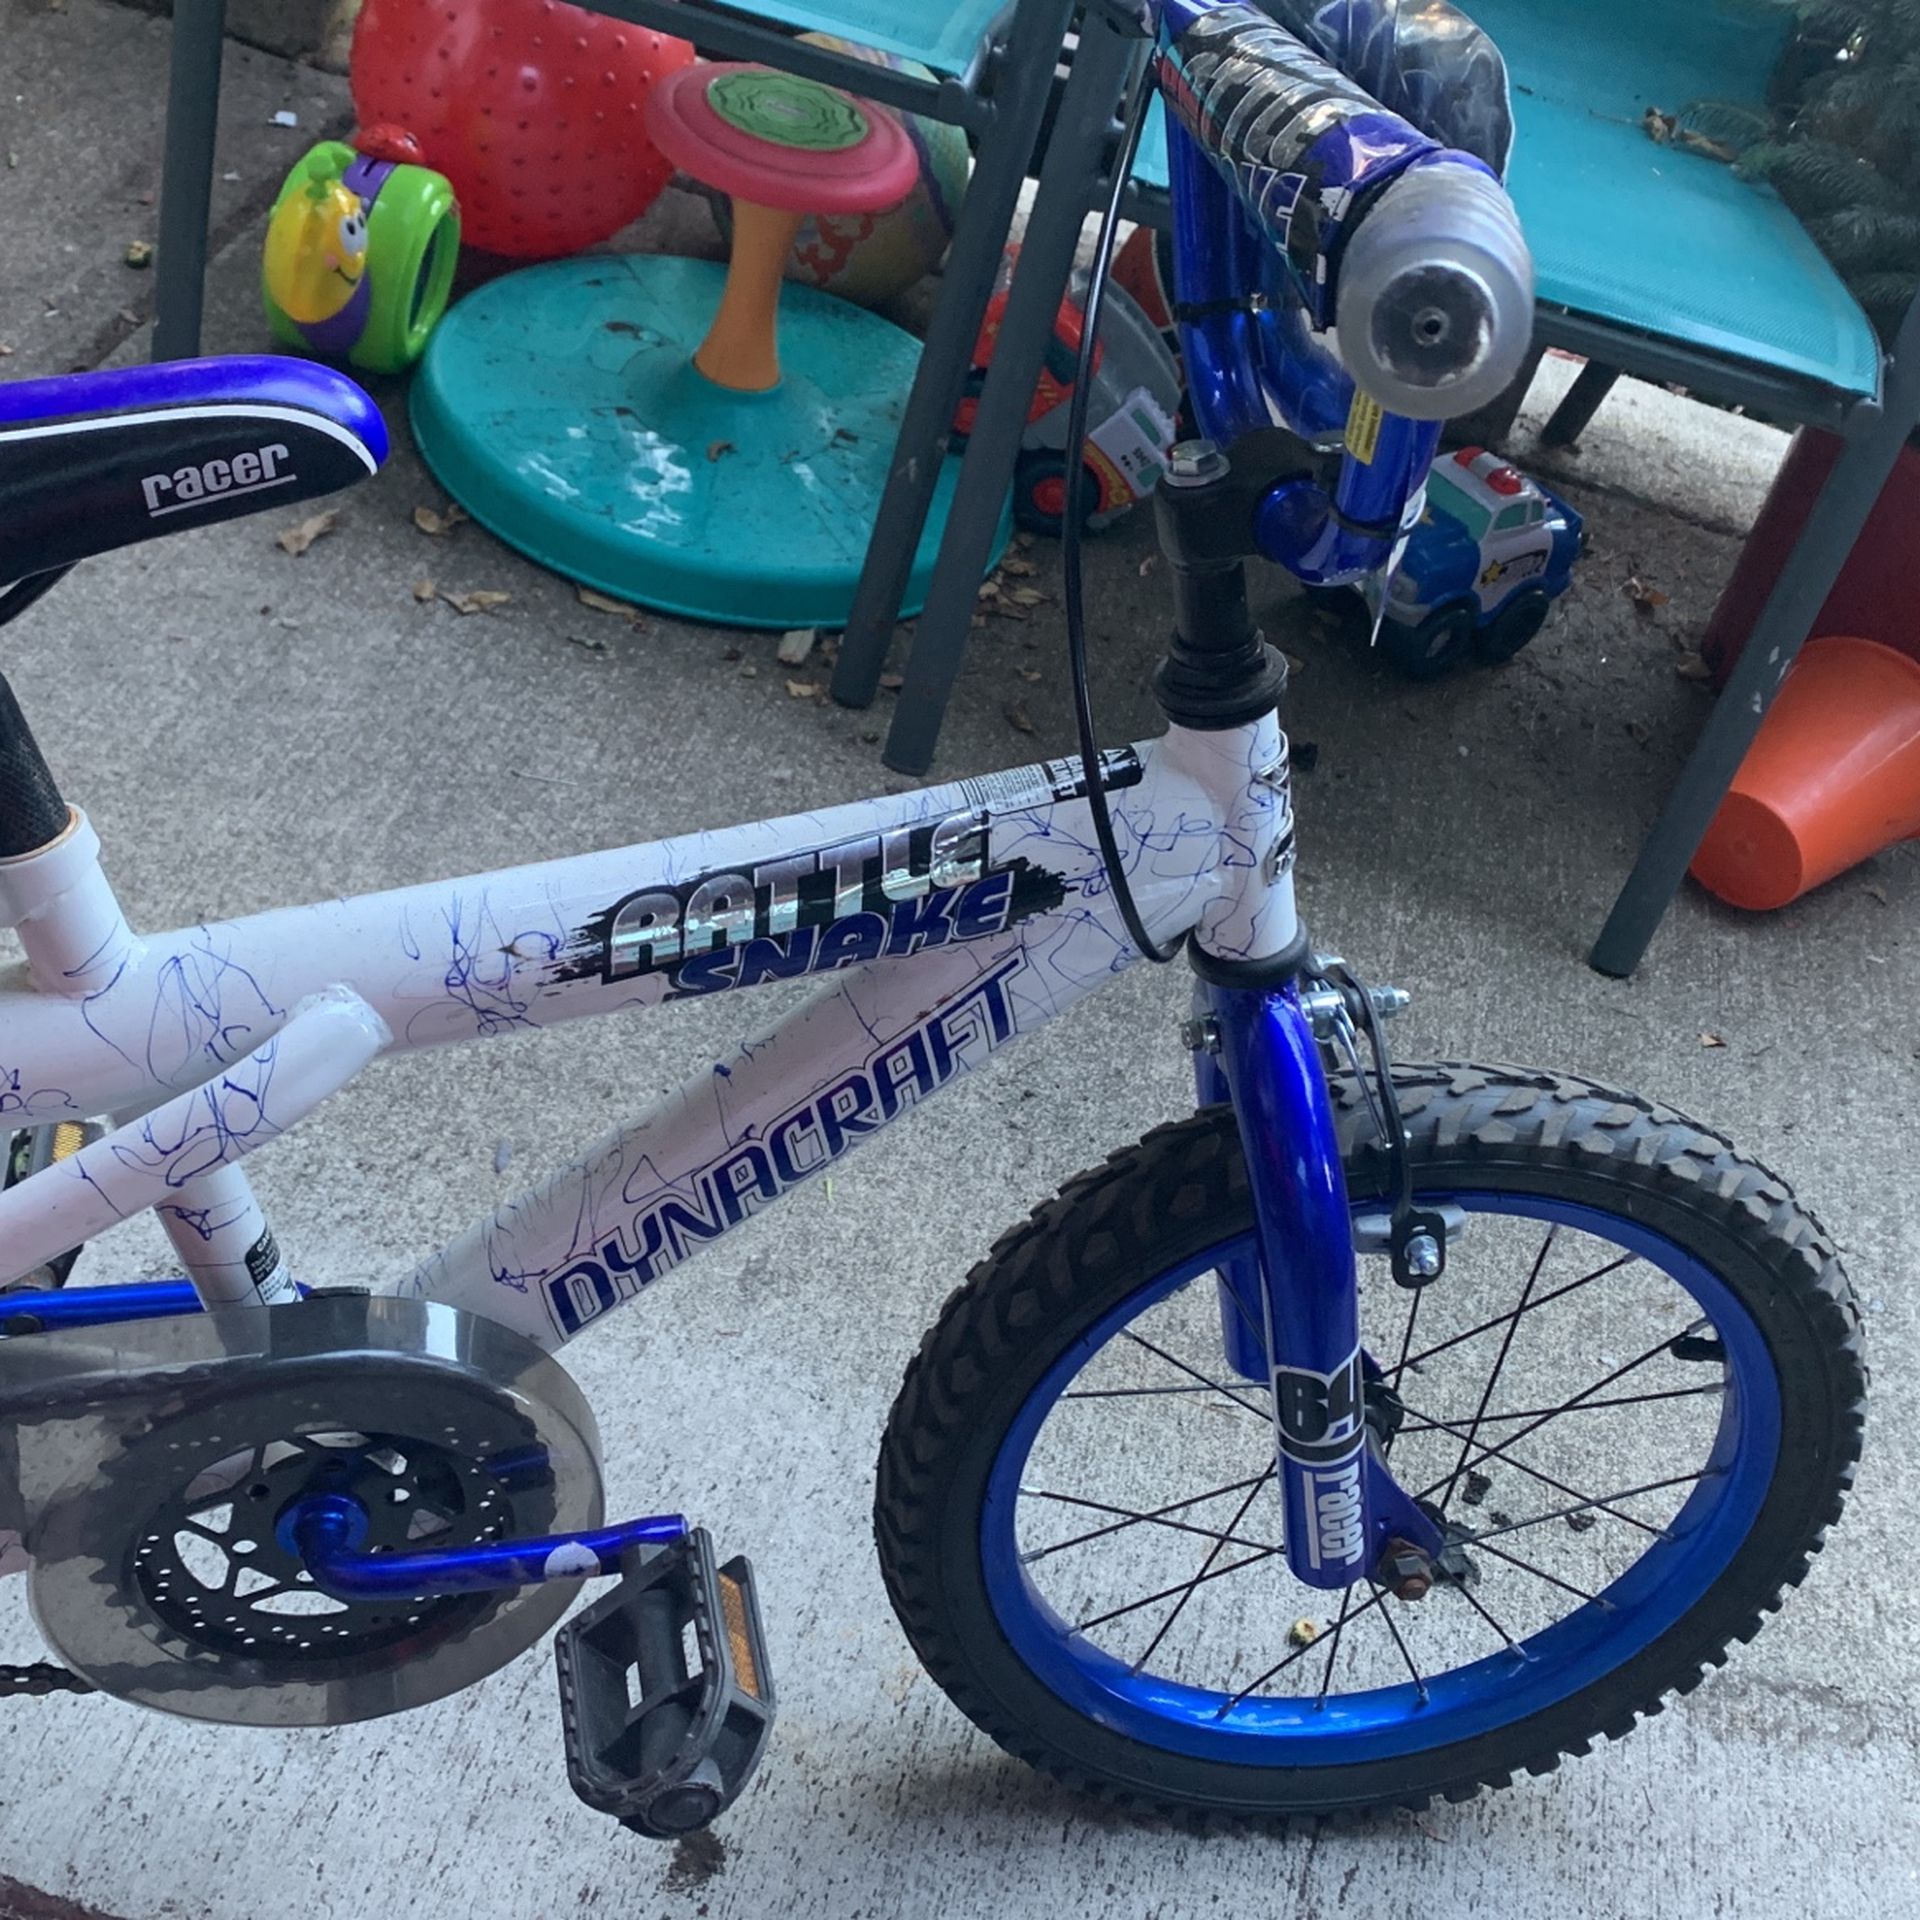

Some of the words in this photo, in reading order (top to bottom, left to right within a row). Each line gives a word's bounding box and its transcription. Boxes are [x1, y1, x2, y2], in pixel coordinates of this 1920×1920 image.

[141, 443, 289, 510] racer
[610, 813, 988, 977] RATTLE
[676, 871, 1015, 994] SNAKE
[540, 947, 1028, 1341] DYNACRAFT
[1315, 1461, 1365, 1567] racer
